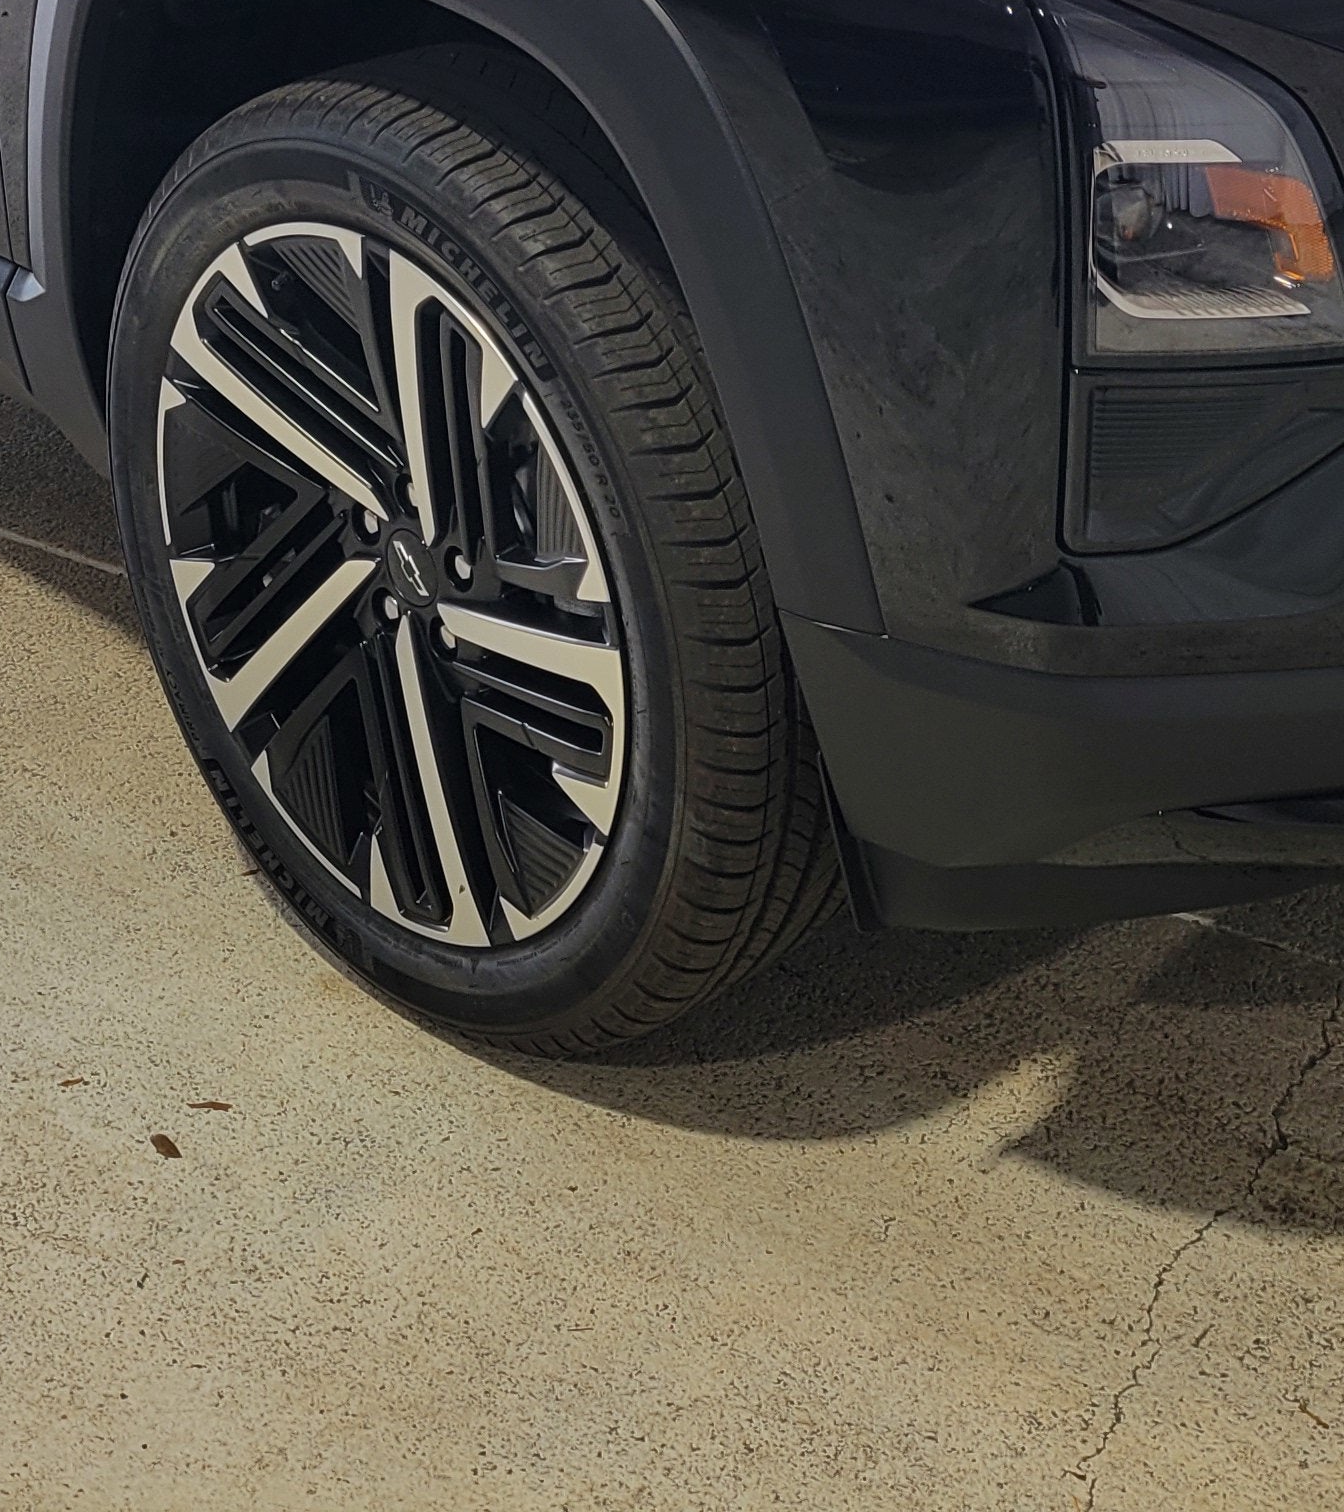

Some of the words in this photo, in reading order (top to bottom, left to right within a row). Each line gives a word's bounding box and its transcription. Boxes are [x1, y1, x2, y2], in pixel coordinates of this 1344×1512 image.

[400, 206, 548, 369] MICHELIN
[603, 495, 622, 520] 20
[210, 769, 330, 928] MICHELIN
